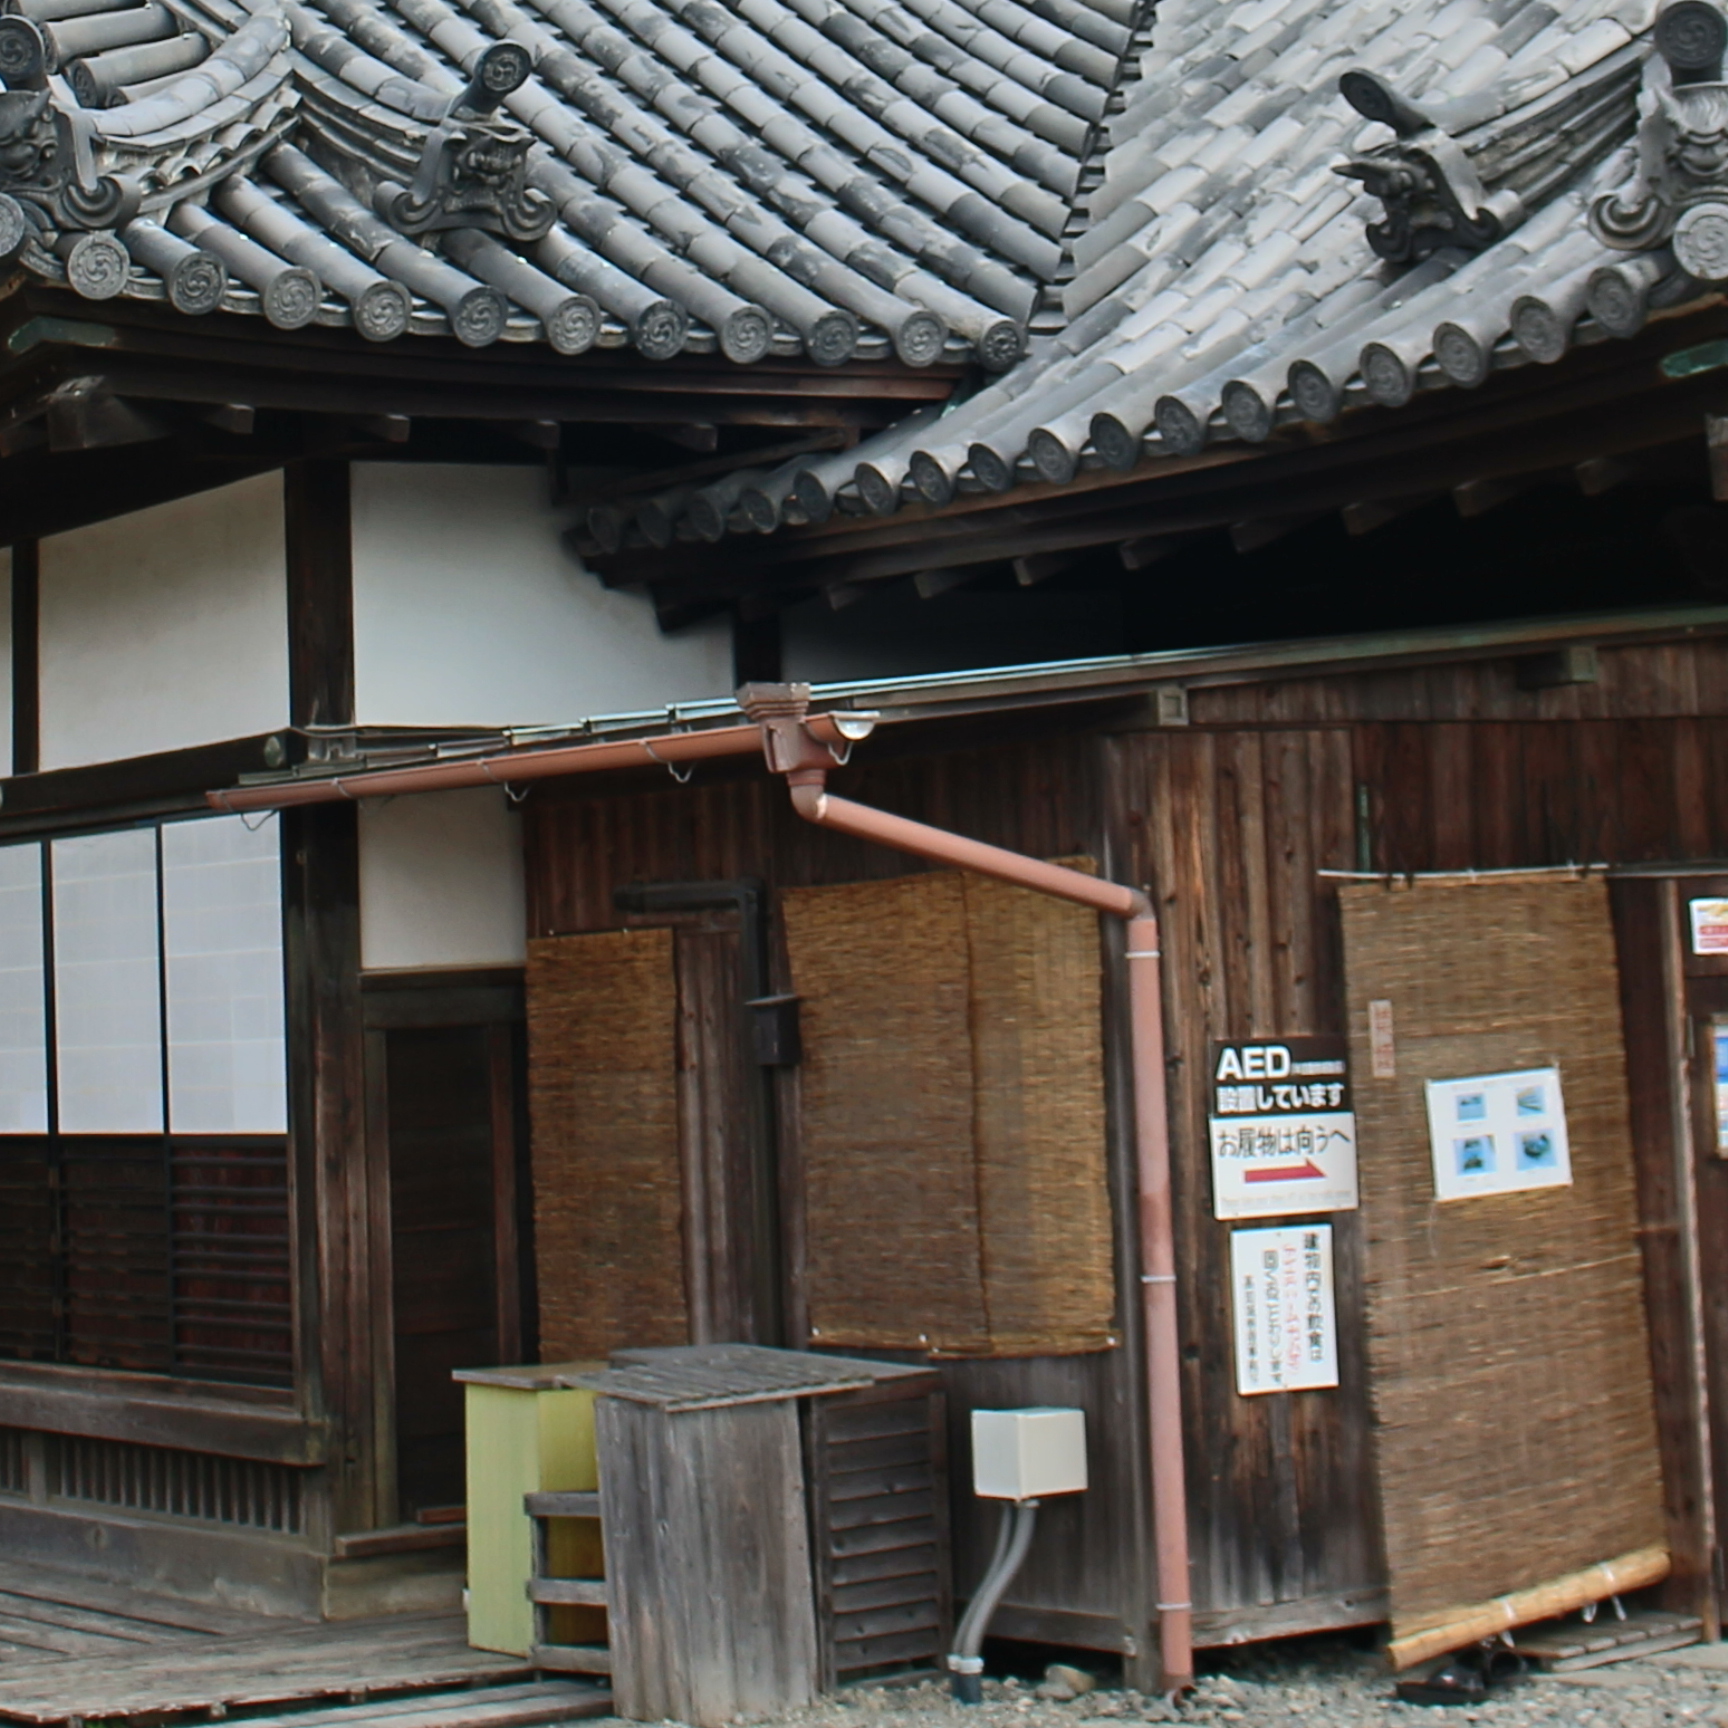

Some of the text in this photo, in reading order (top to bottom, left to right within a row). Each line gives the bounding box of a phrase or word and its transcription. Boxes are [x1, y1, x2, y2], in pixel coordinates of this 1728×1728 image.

[1215, 1045, 1291, 1081] AED
[1216, 1083, 1345, 1113] 設置しています
[1217, 1125, 1351, 1158] お履物は向うへ
